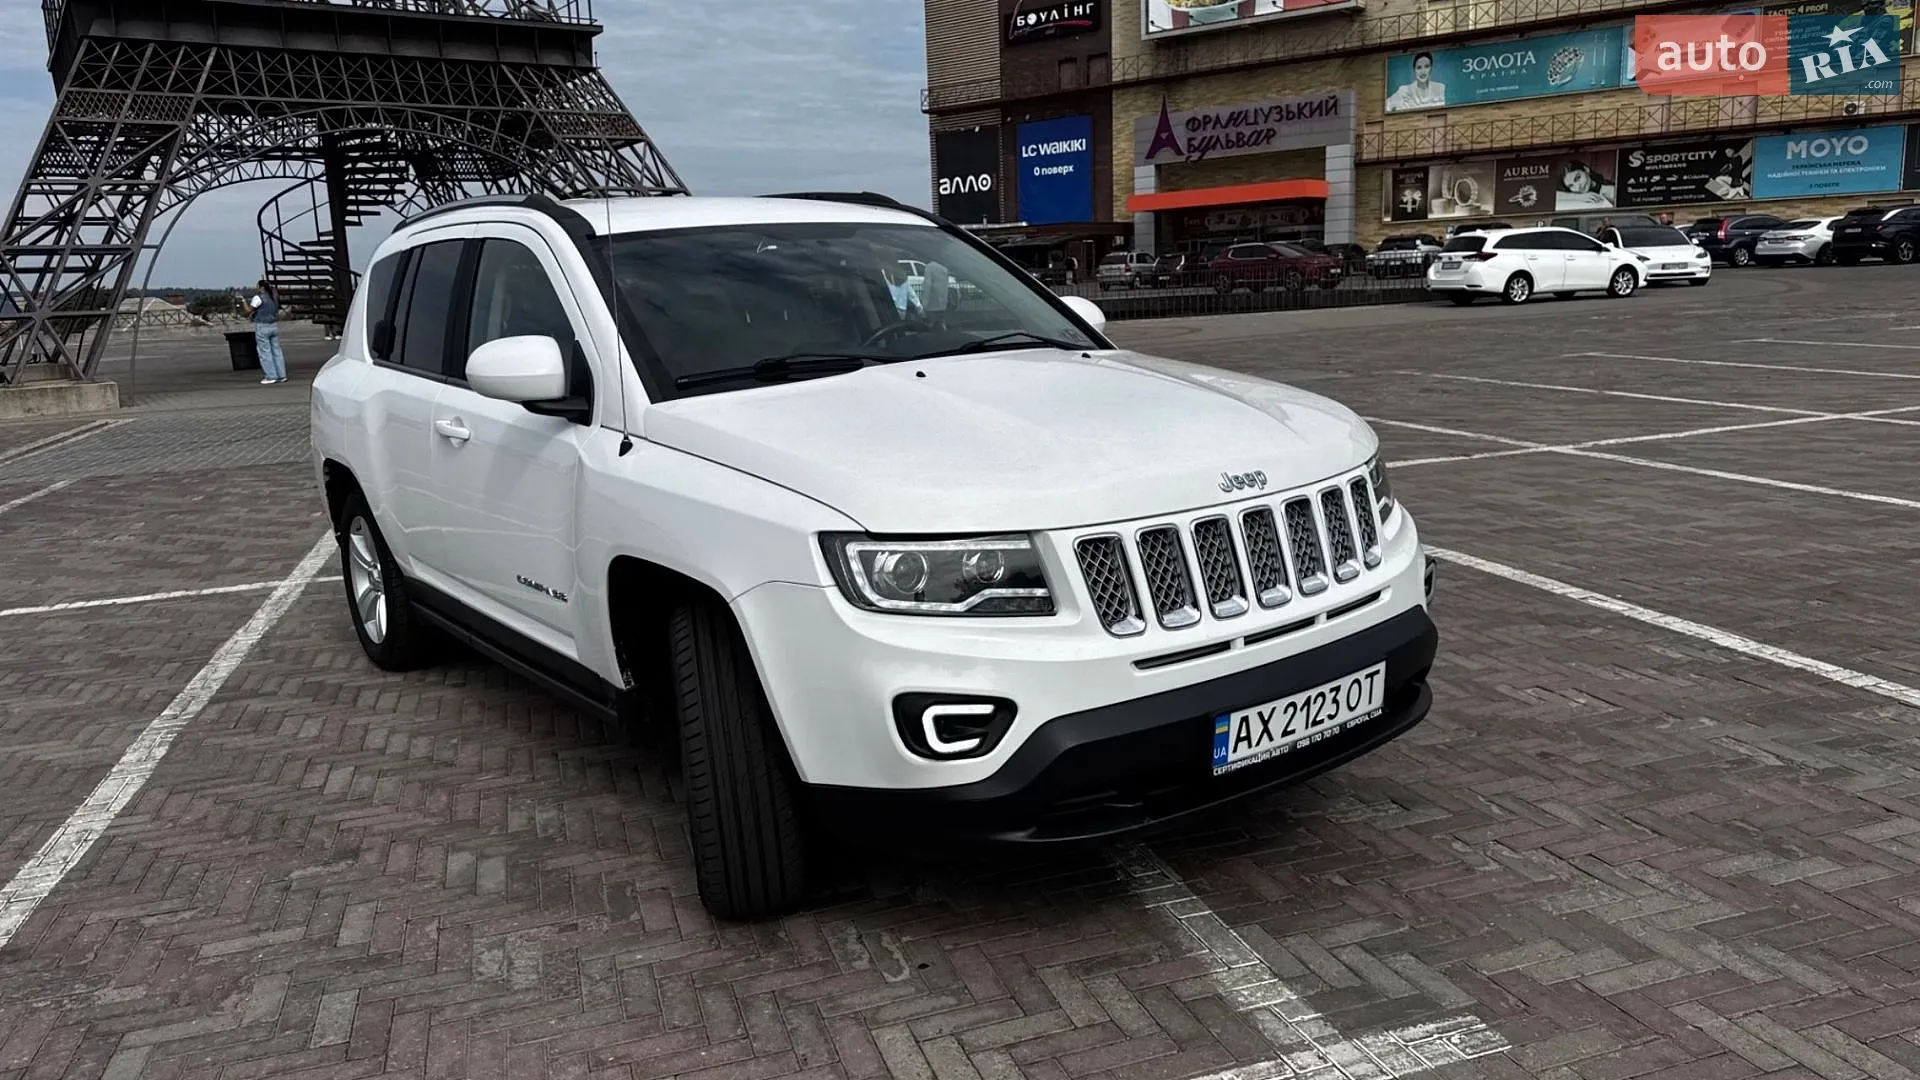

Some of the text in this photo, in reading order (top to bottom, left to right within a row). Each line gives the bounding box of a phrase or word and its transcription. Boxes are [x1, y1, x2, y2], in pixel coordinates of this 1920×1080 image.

[1462, 50, 1536, 73] ЗОЛОТА
[1185, 95, 1339, 133] ФРАНЦУЗЬКИЙ
[1021, 144, 1038, 158] LC
[1185, 128, 1277, 164] БУЛЬВАР
[1646, 150, 1717, 164] SPORTCITY
[1786, 135, 1869, 160] MOYO
[1041, 164, 1075, 177] поверх
[1503, 164, 1550, 177] AURUM
[1217, 470, 1268, 493] Jeep
[1232, 669, 1381, 754] AX 2123 OT
[1213, 747, 1227, 759] UA
